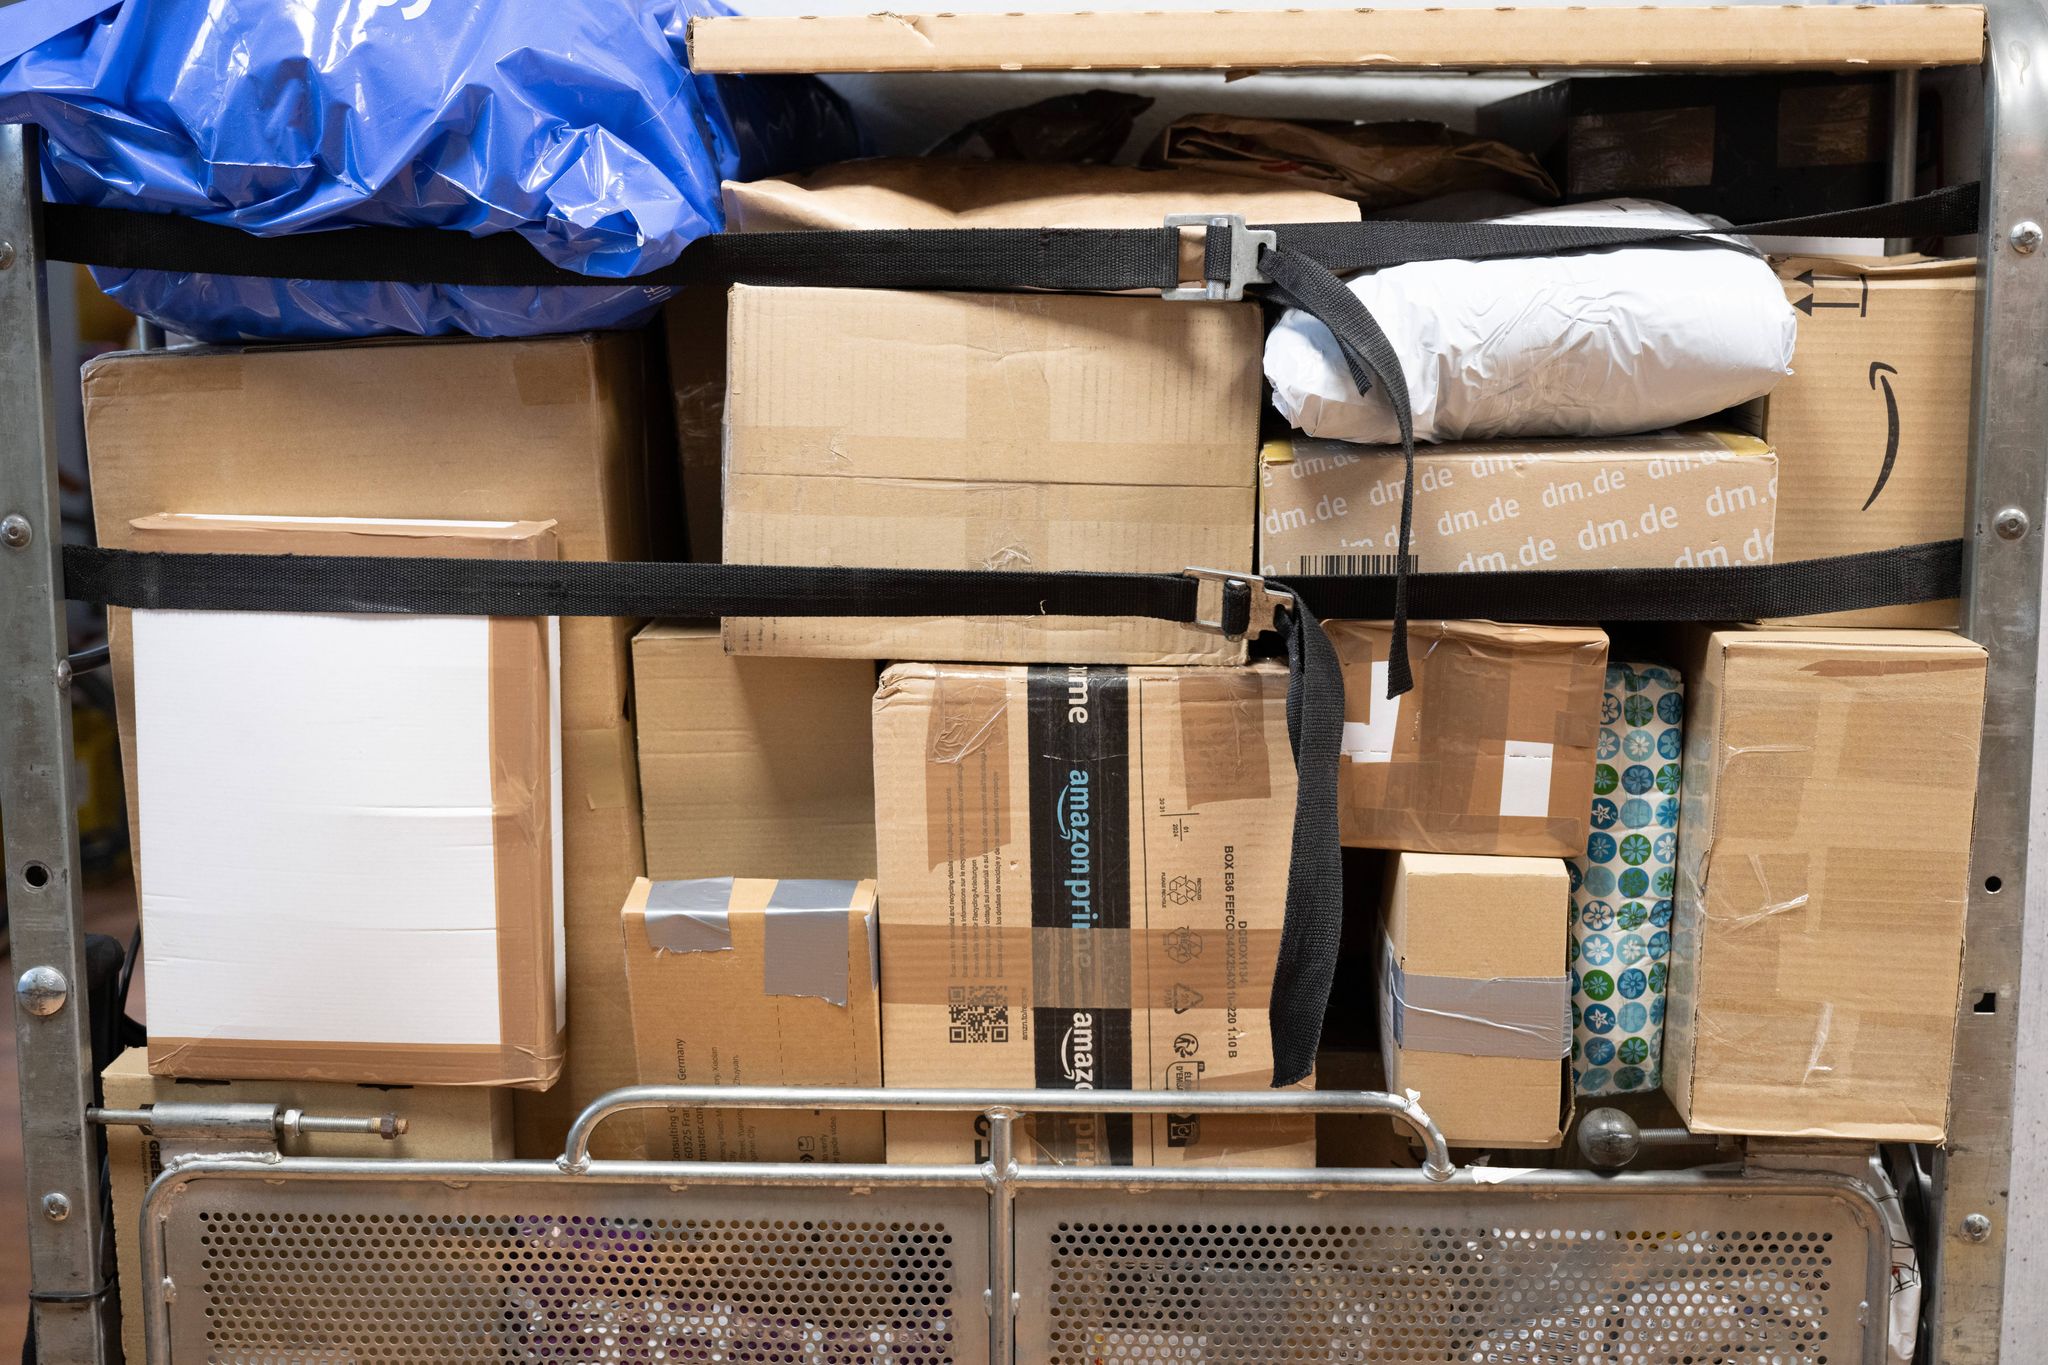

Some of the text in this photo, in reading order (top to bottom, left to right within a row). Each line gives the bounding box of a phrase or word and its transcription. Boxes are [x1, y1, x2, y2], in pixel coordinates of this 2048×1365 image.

[1290, 454, 1361, 479] dm.de
[1647, 450, 1735, 480] dm.de
[1369, 466, 1454, 507] dm.de
[1541, 467, 1627, 508] dm.de
[1264, 494, 1348, 535] dm.de
[1437, 496, 1521, 536] dm.de
[1577, 503, 1679, 551] dm.de
[1457, 536, 1557, 573] dm.de
[1069, 769, 1090, 874] amazon
[1224, 845, 1235, 870] BOX
[1224, 872, 1236, 892] E36
[1225, 895, 1237, 931] FEFCO
[1072, 1012, 1094, 1090] amaz
[1228, 1026, 1239, 1047] 1.10
[1228, 1050, 1238, 1058] B
[676, 1039, 687, 1080] Germany
[683, 1130, 693, 1158] 60325
[1068, 1117, 1097, 1166] pri
